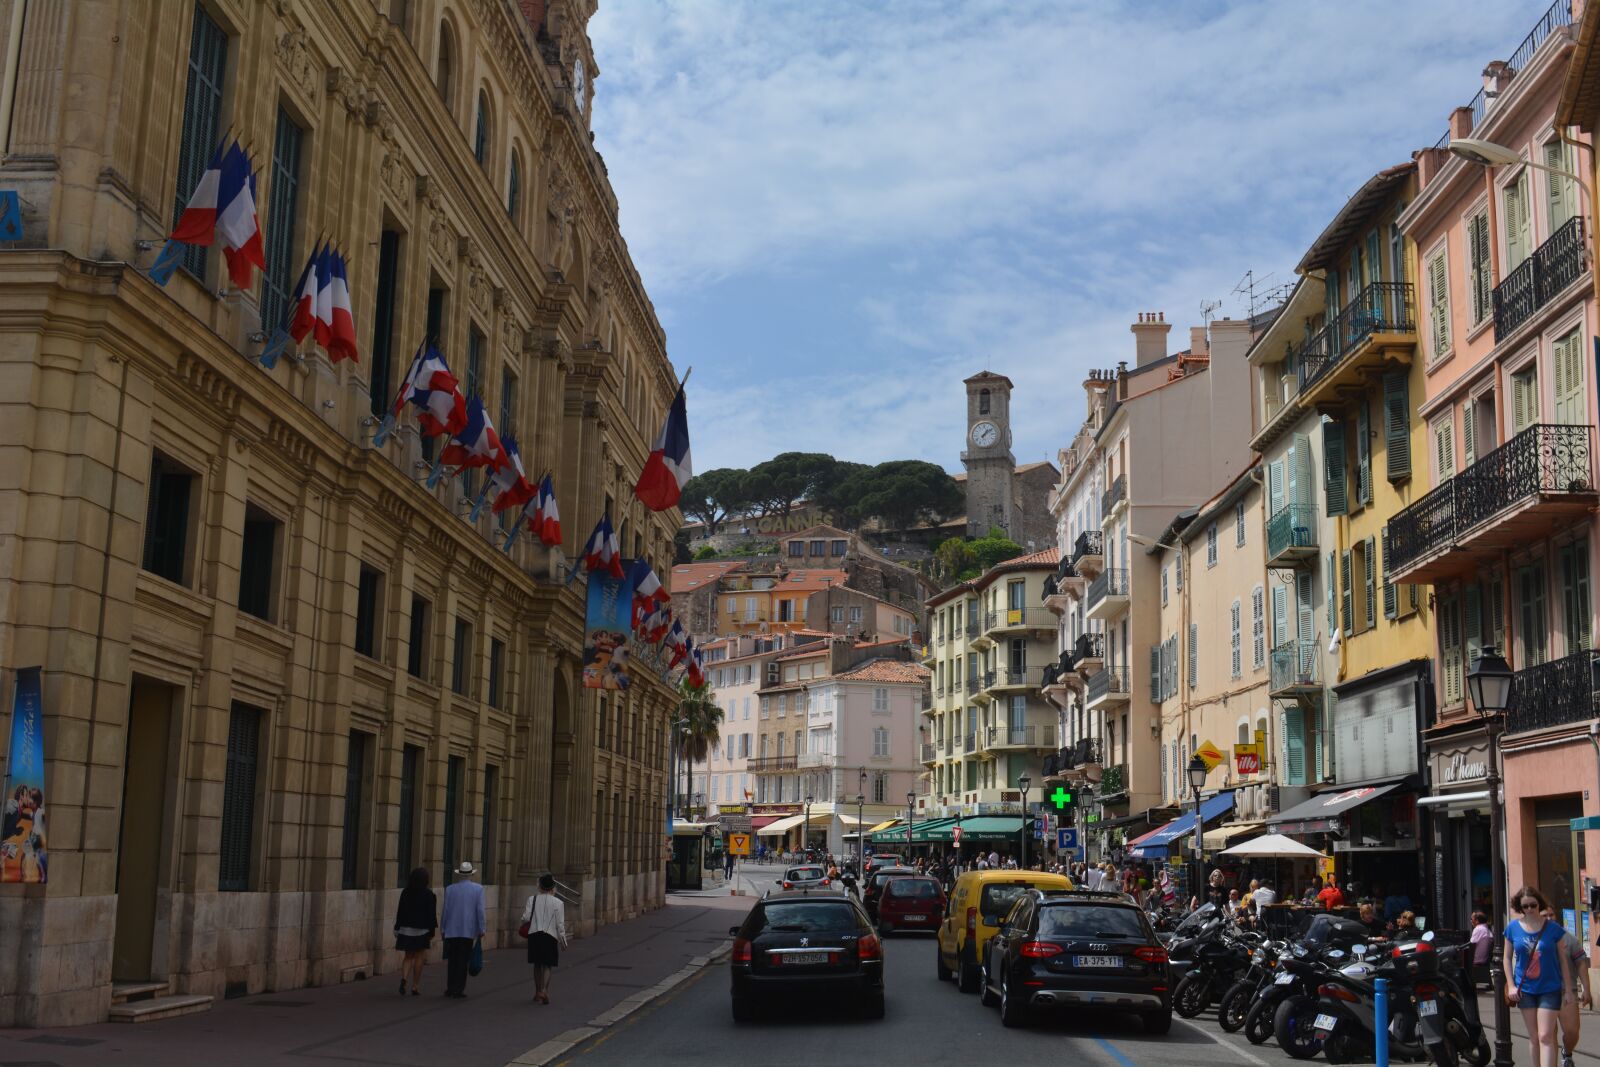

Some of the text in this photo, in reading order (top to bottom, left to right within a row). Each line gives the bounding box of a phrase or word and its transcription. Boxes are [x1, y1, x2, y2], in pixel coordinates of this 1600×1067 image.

[759, 512, 833, 533] CANNES
[1239, 756, 1257, 773] illy
[1063, 833, 1072, 846] P
